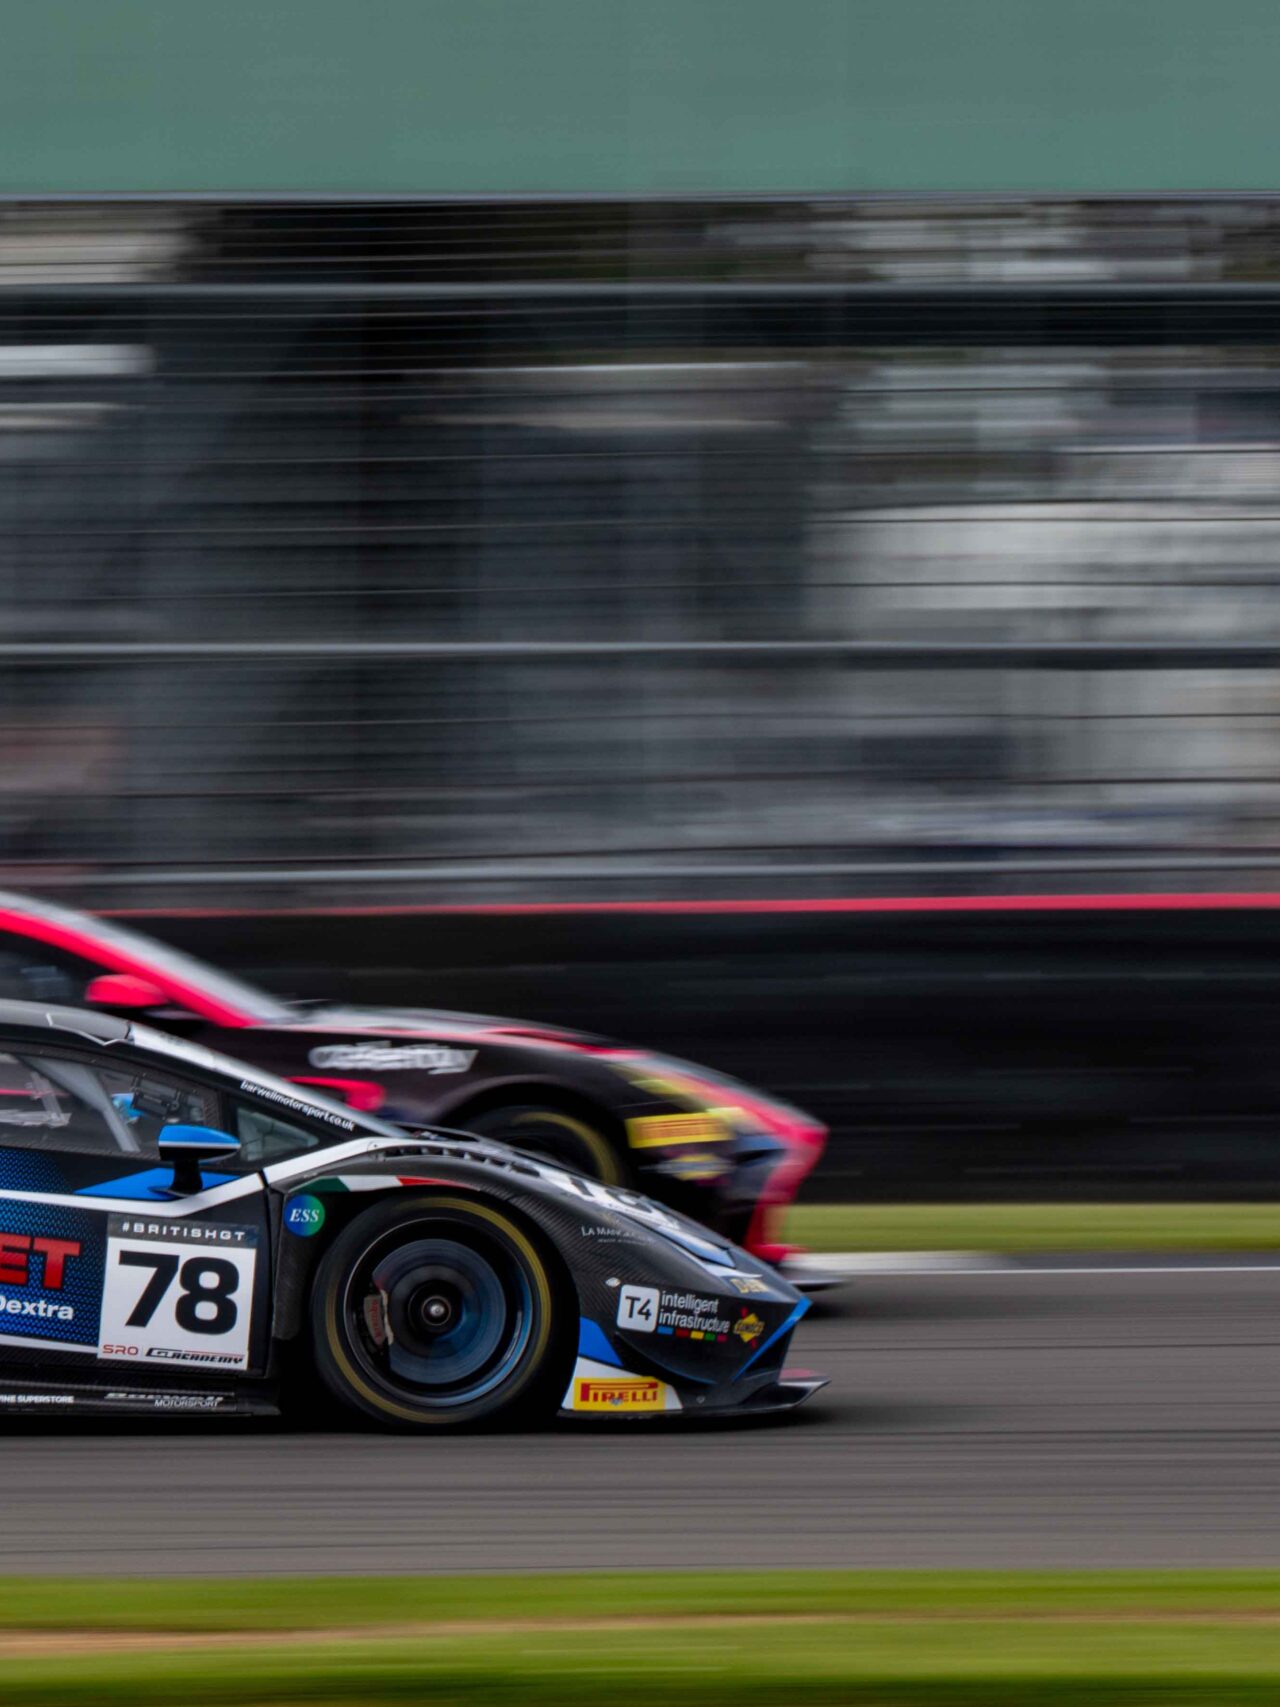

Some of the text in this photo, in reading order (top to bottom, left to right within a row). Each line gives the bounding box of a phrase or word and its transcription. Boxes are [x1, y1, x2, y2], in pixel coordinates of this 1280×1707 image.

[240, 1080, 355, 1132] barwellmotorsport.co.uk
[290, 1208, 319, 1222] ESS
[122, 1222, 245, 1241] #BRITISHGT
[119, 1250, 239, 1335] 78
[661, 1290, 719, 1314] intelligent
[625, 1295, 652, 1321] T4
[659, 1309, 730, 1333] infrastructure
[102, 1344, 139, 1356] SRO
[17, 1394, 75, 1404] SUPERSTORE
[580, 1382, 658, 1402] PIRELLI
